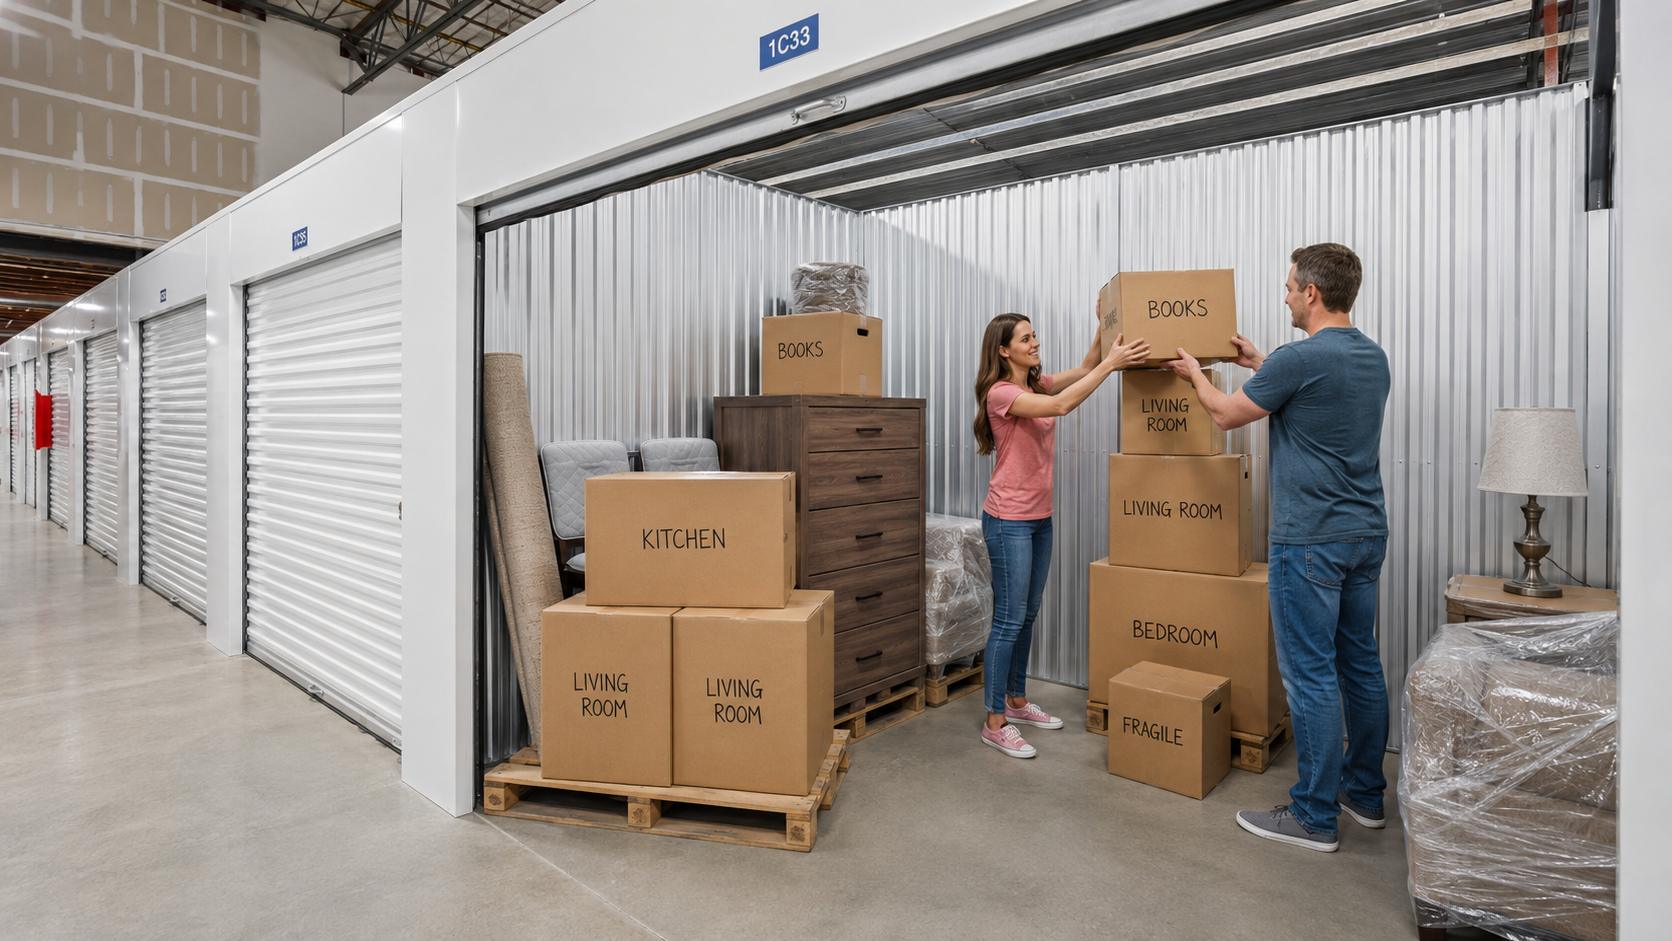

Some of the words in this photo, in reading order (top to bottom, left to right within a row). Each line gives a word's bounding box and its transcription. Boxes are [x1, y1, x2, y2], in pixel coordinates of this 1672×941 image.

[768, 25, 811, 58] 1C33
[1148, 299, 1209, 319] BOOKS
[778, 341, 824, 360] BOOKS
[1141, 398, 1189, 414] LIVING
[1147, 417, 1187, 432] ROOM
[1123, 500, 1172, 518] LIVING
[1179, 502, 1223, 520] ROOM
[642, 528, 726, 550] KITCHEN
[1132, 620, 1219, 649] BEDROOM
[573, 672, 629, 693] LIVING
[706, 678, 763, 699] LIVING
[582, 697, 628, 718] ROOM
[714, 703, 762, 725] ROOM
[1123, 717, 1184, 746] FRAGILE
